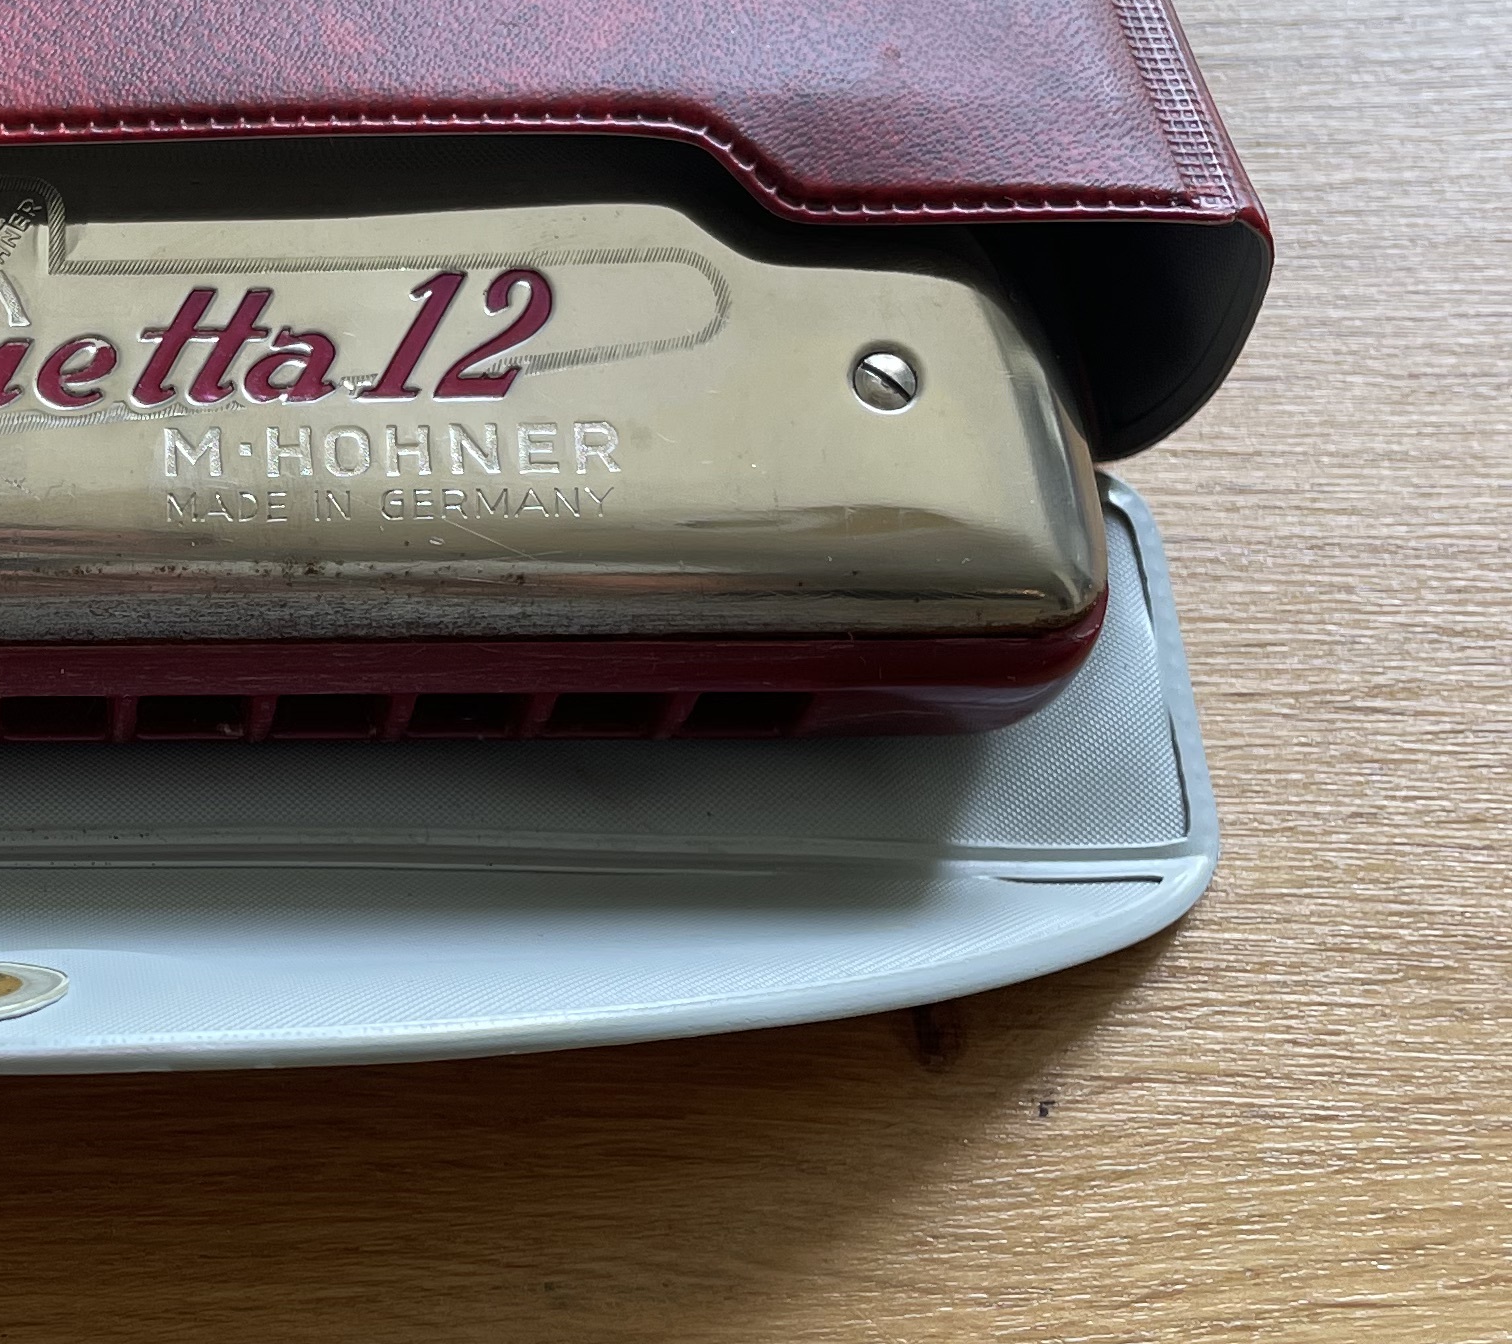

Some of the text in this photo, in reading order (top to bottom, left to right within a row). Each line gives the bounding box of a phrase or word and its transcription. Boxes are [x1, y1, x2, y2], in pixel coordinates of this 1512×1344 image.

[353, 267, 554, 403] 12
[166, 485, 615, 523] MADE IN GERMANY
